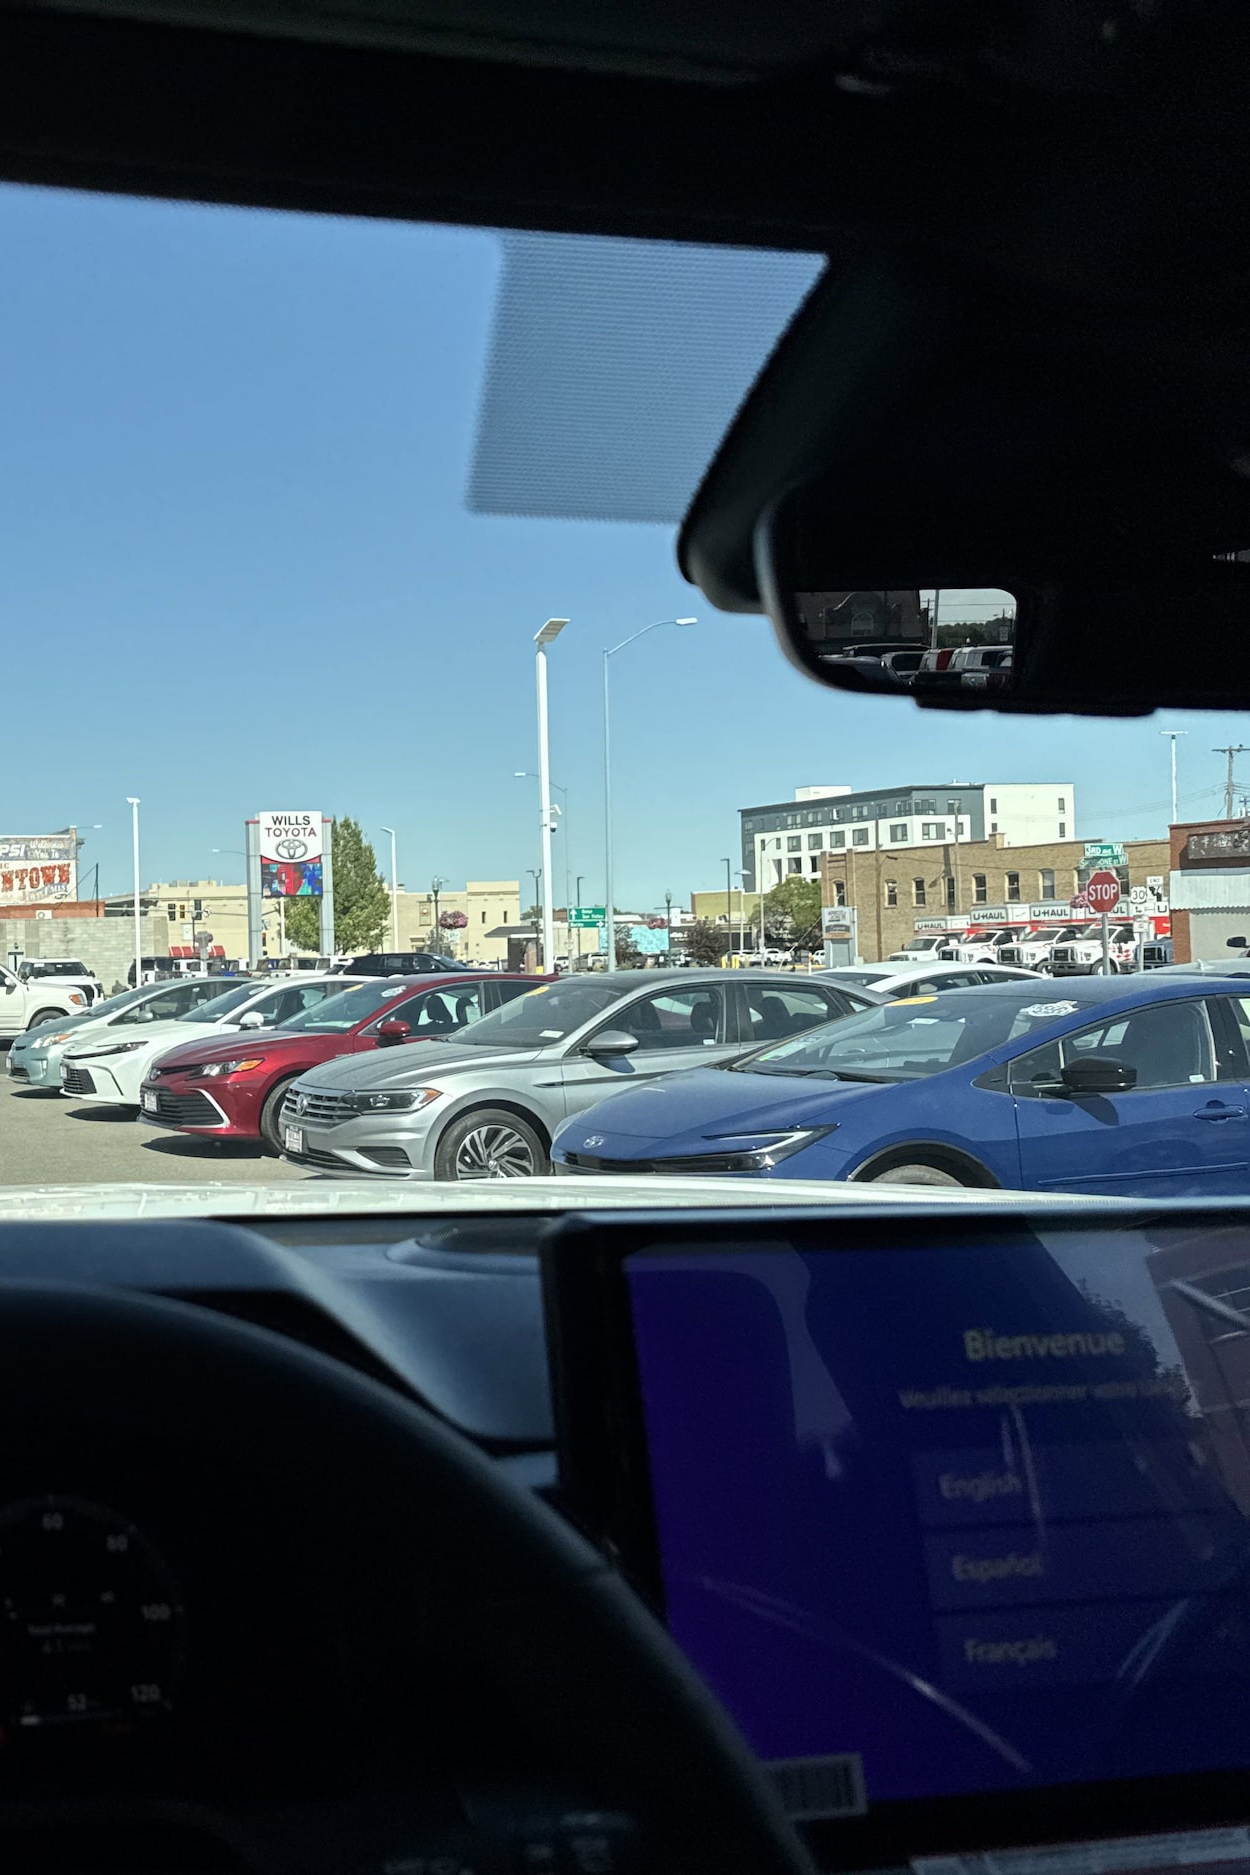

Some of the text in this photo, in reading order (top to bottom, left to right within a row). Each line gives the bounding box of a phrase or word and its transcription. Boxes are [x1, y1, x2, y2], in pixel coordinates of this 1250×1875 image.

[272, 815, 311, 826] WILLS
[264, 827, 317, 838] TOYOTA
[1085, 846, 1102, 856] 3RD
[1112, 845, 1122, 855] W
[1118, 855, 1127, 865] W
[1088, 883, 1118, 901] STOP
[1132, 889, 1146, 900] 30
[973, 911, 1006, 921] U-HAUL
[1032, 908, 1069, 918] U-HAUL
[963, 1329, 1126, 1360] Bienvenue
[939, 1472, 1023, 1501] English
[951, 1553, 1044, 1583] Español
[963, 1638, 1057, 1667] Français
